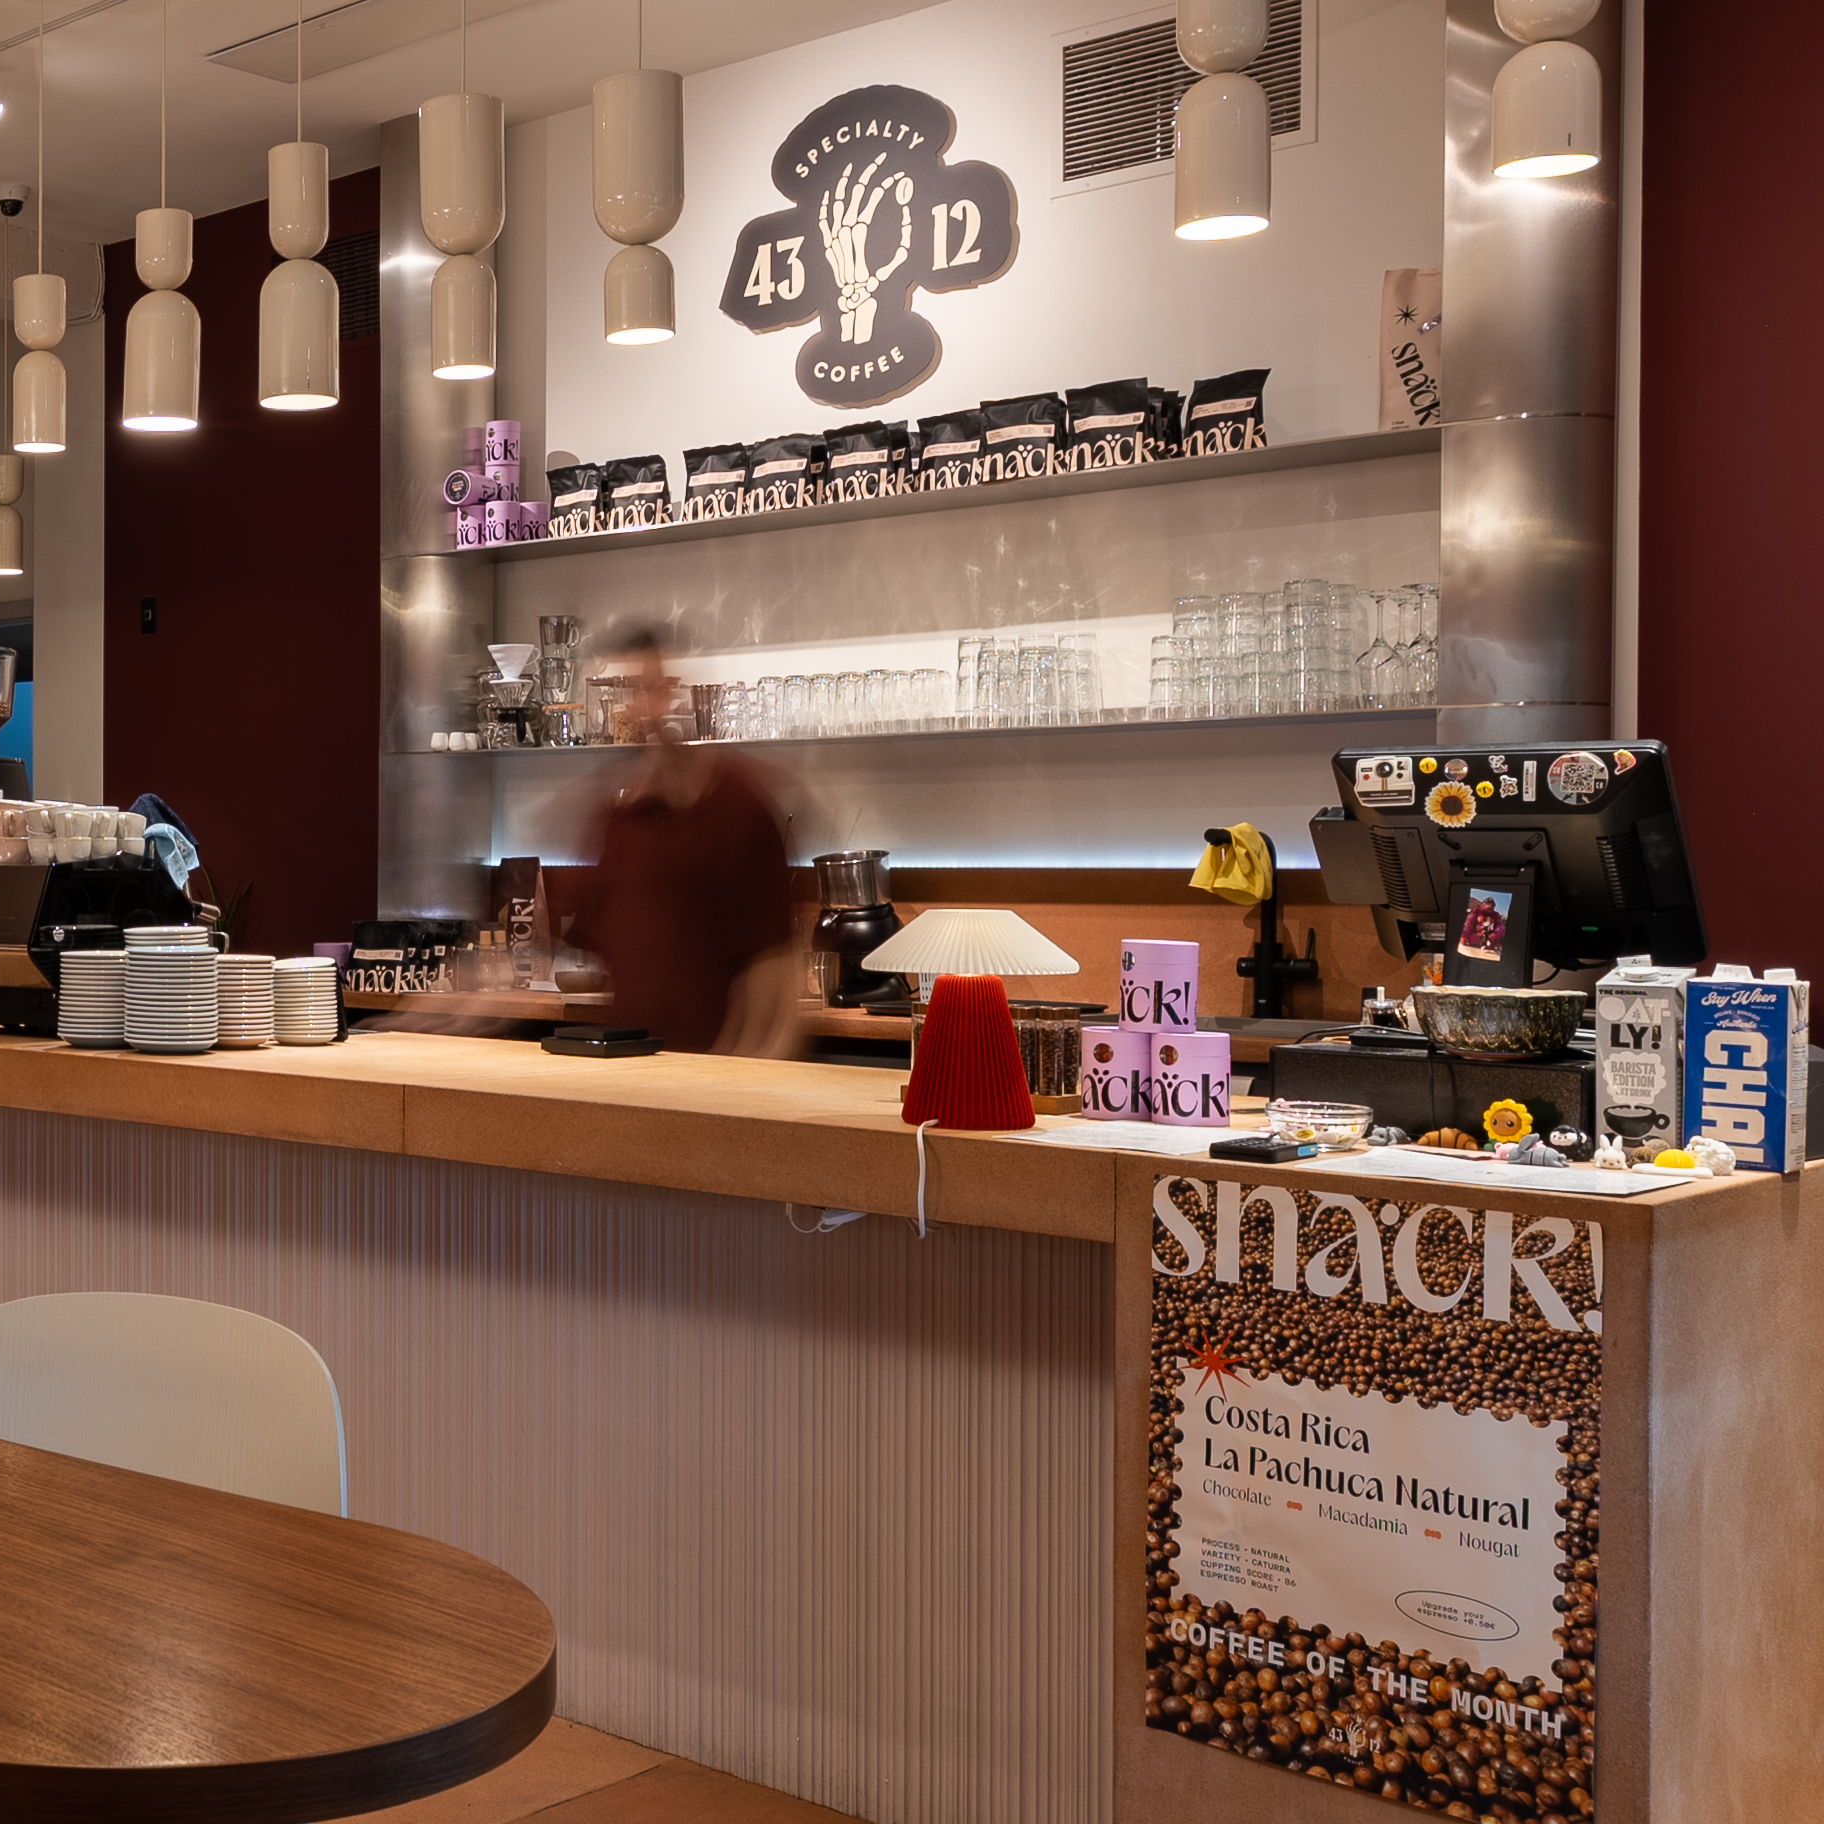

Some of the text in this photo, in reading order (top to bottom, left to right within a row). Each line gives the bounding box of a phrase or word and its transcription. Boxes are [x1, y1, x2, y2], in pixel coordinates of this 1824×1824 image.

[795, 119, 925, 178] SPECIALTY
[931, 198, 982, 272] 12
[743, 235, 806, 307] 43
[814, 346, 905, 383] COFFEE
[1700, 987, 1777, 1008] Say When
[1610, 1023, 1662, 1050] LY!
[1611, 1060, 1657, 1075] BARISTA
[1613, 1074, 1655, 1088] EDITION
[1204, 1394, 1370, 1455] Costa Rica
[1204, 1437, 1530, 1531] La Pachuca Natural
[1202, 1478, 1521, 1559] Chocolate Macadamia Nougat
[1201, 1537, 1291, 1564] PROCESS NATURAL
[1201, 1548, 1291, 1575] VARIETY CATURRA
[1200, 1559, 1242, 1574] CUPPING
[1246, 1569, 1274, 1582] SCORE
[1200, 1569, 1279, 1593] ESPRESSO ROAST
[1417, 1607, 1459, 1622] espresso
[1421, 1600, 1485, 1620] Upgrade your
[1170, 1617, 1563, 1740] COFFEE OF THE MONTH
[1328, 1727, 1343, 1742] 43
[1369, 1738, 1381, 1754] 12
